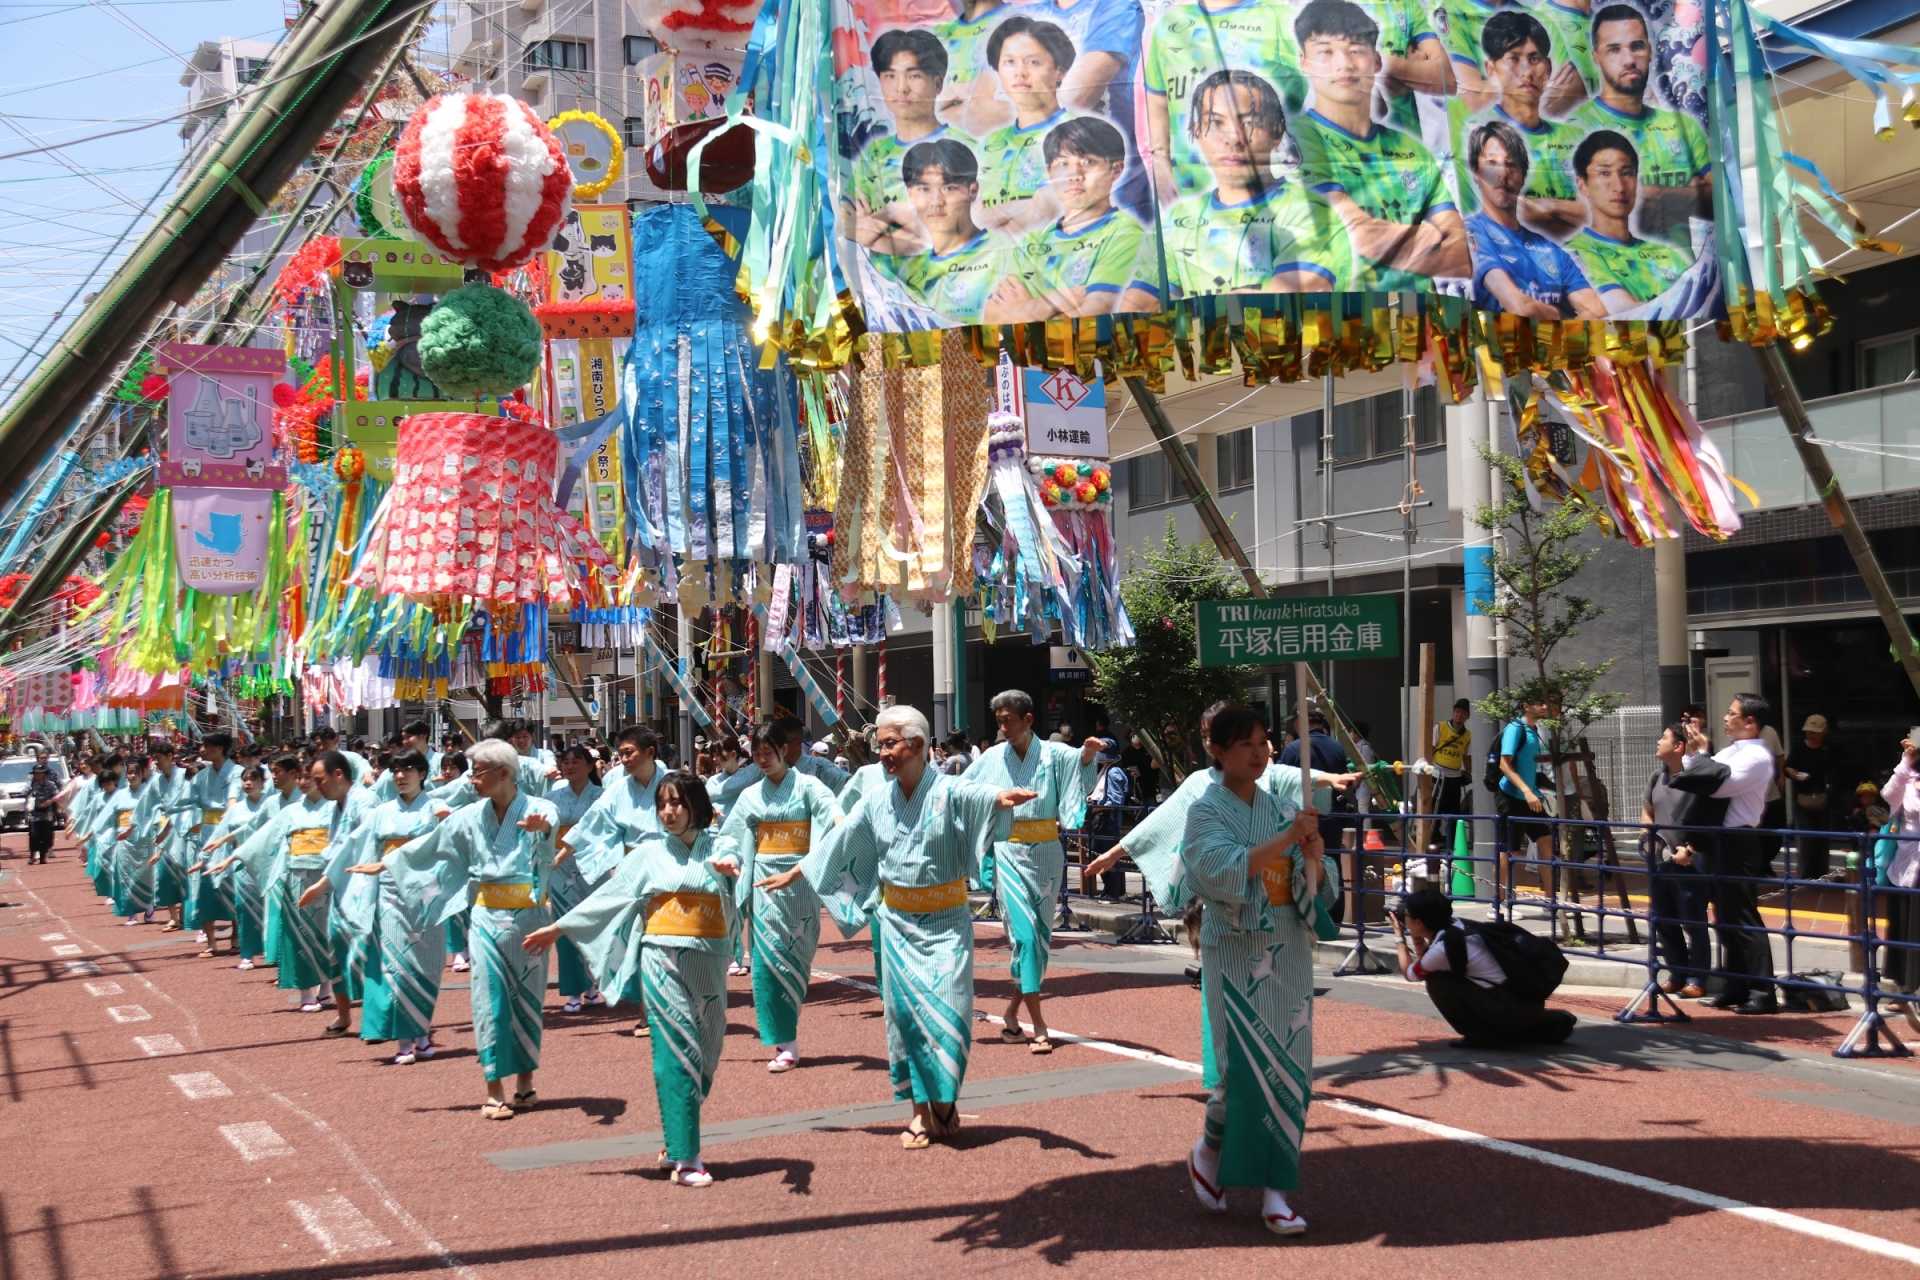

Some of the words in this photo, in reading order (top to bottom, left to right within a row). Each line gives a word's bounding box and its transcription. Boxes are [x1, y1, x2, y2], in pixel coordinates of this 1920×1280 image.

[1055, 377, 1076, 401] K
[591, 357, 609, 480] 湘南ひらつ夕祭り
[1046, 428, 1091, 444] 小林運輸
[189, 556, 234, 568] 迅速かつ
[190, 570, 257, 582] 高い分析技術
[1217, 604, 1250, 623] TRI
[1252, 603, 1292, 621] bank
[1292, 601, 1361, 618] Hiratsuka
[1218, 621, 1383, 659] 平塚信用金庫
